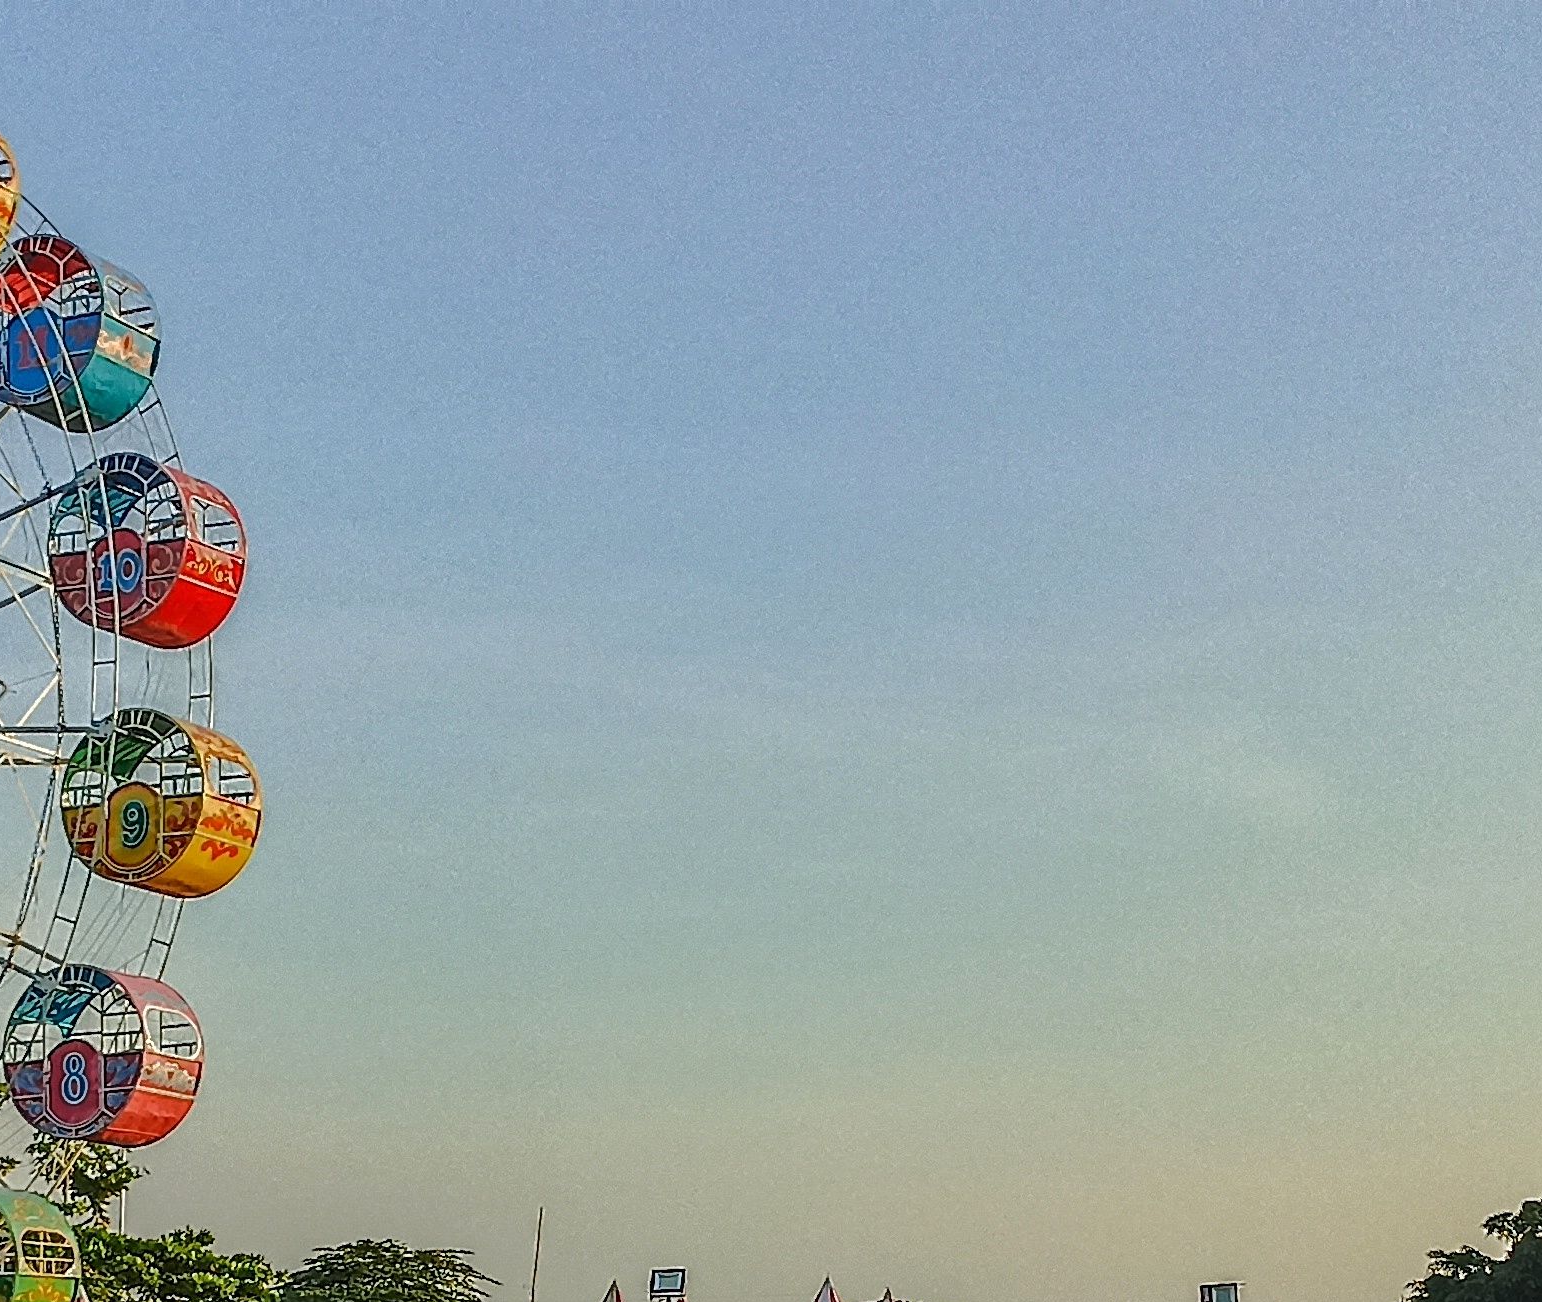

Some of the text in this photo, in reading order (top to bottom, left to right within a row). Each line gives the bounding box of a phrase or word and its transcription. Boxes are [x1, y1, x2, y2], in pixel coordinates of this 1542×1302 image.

[97, 548, 142, 593] 10
[122, 799, 149, 848] 9
[61, 1051, 88, 1105] 8
